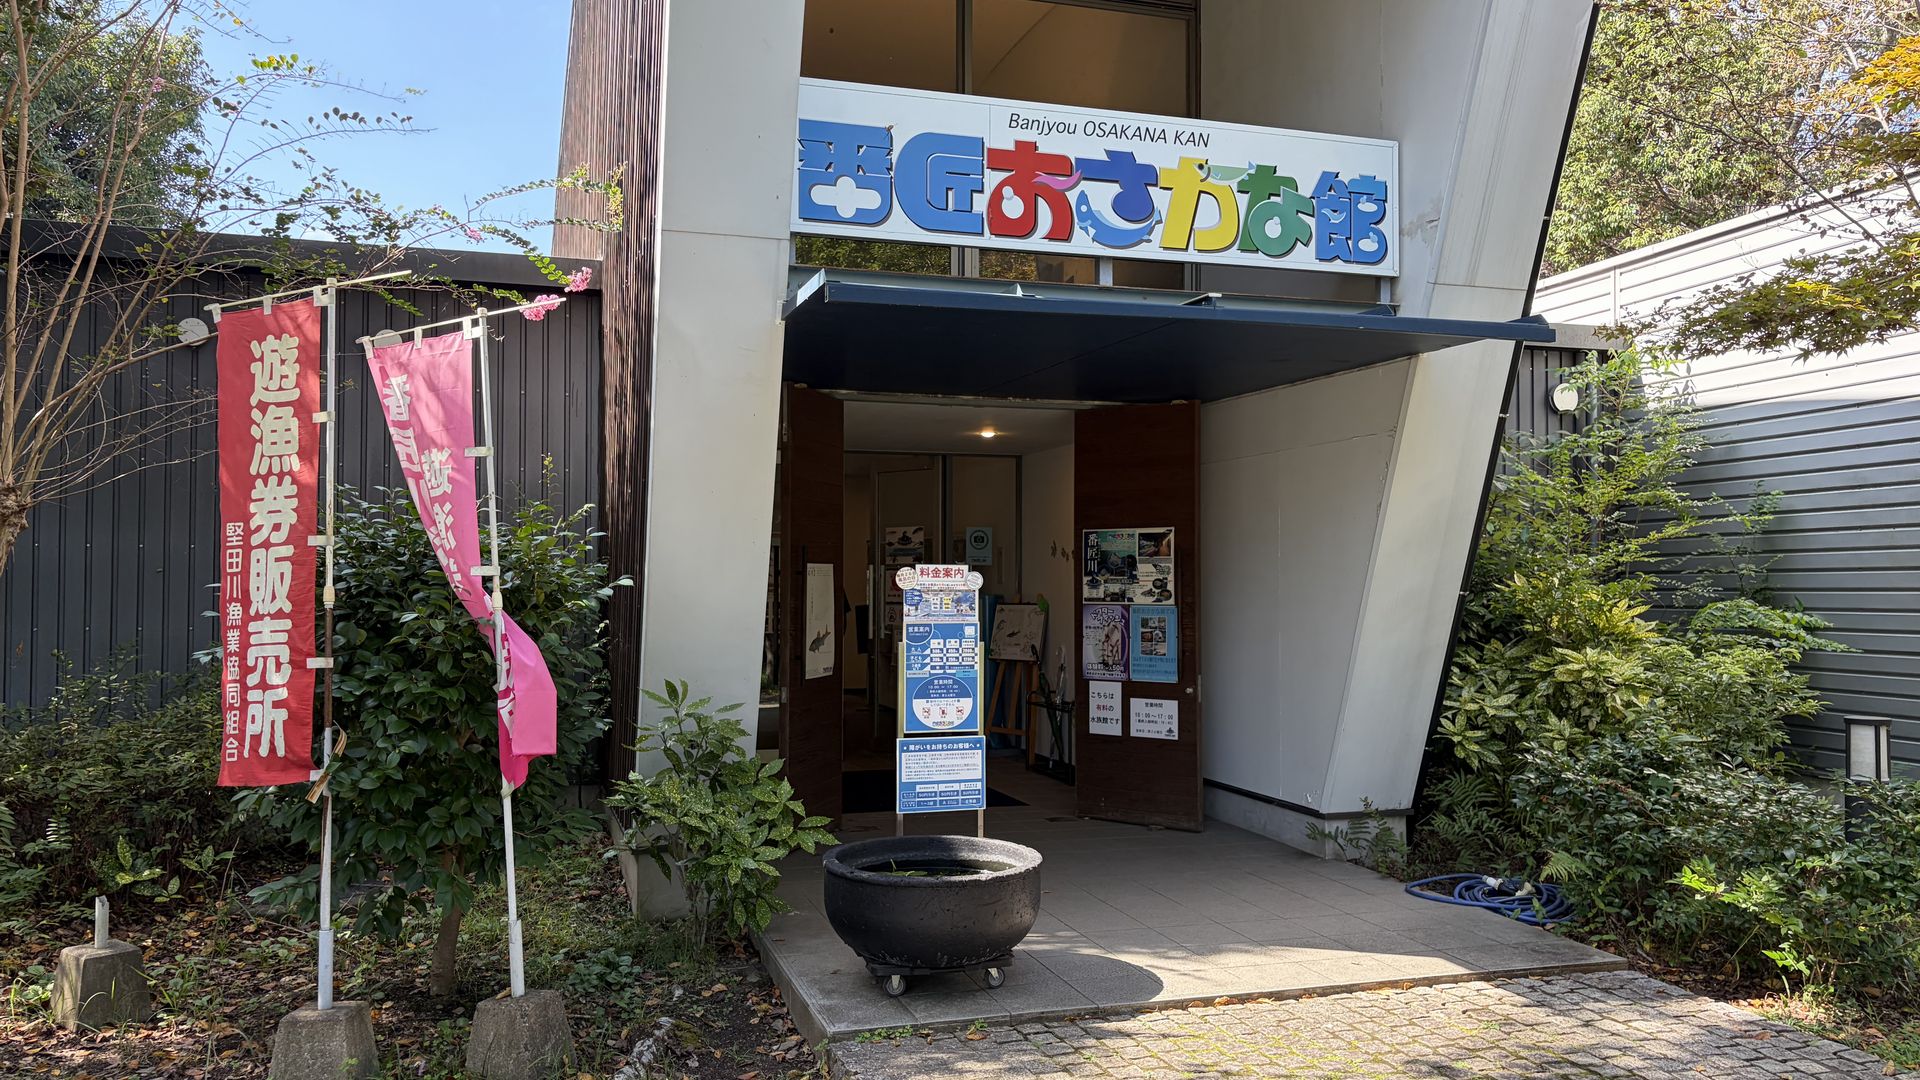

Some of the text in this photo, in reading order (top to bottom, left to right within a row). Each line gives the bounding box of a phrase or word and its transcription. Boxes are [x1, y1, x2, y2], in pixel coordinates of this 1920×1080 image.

[1008, 112, 1210, 148] Banjyou OSAKANA KAN
[798, 118, 1388, 264] 番匠おさかな館
[243, 334, 300, 758] 遊漁券販売所
[919, 566, 965, 579] 料金案内
[225, 522, 244, 762] 堅田川漁業協同組合
[1091, 691, 1115, 700] こちらは
[1096, 704, 1115, 712] 有料の
[1090, 716, 1121, 726] 水族館です
